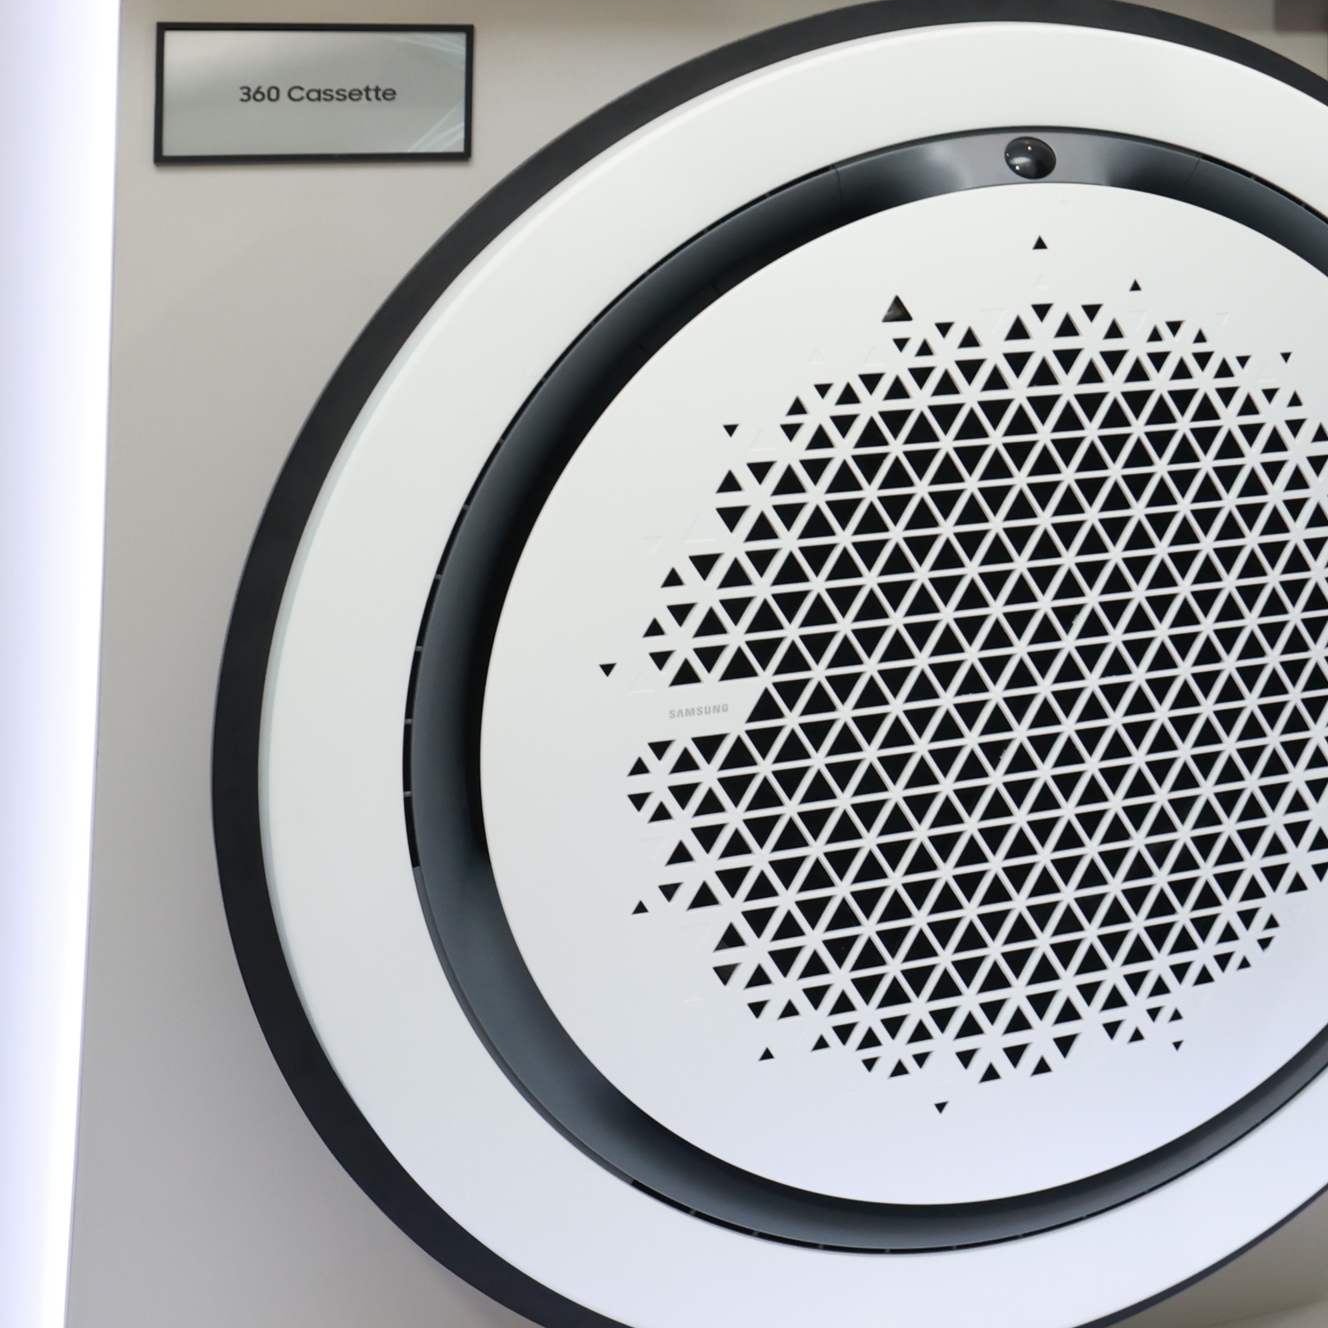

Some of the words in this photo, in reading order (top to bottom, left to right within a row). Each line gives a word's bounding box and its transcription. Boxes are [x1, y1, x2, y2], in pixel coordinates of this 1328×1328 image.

[239, 85, 280, 103] 360
[287, 84, 397, 103] Cassette
[669, 703, 729, 719] SAMSUNG
